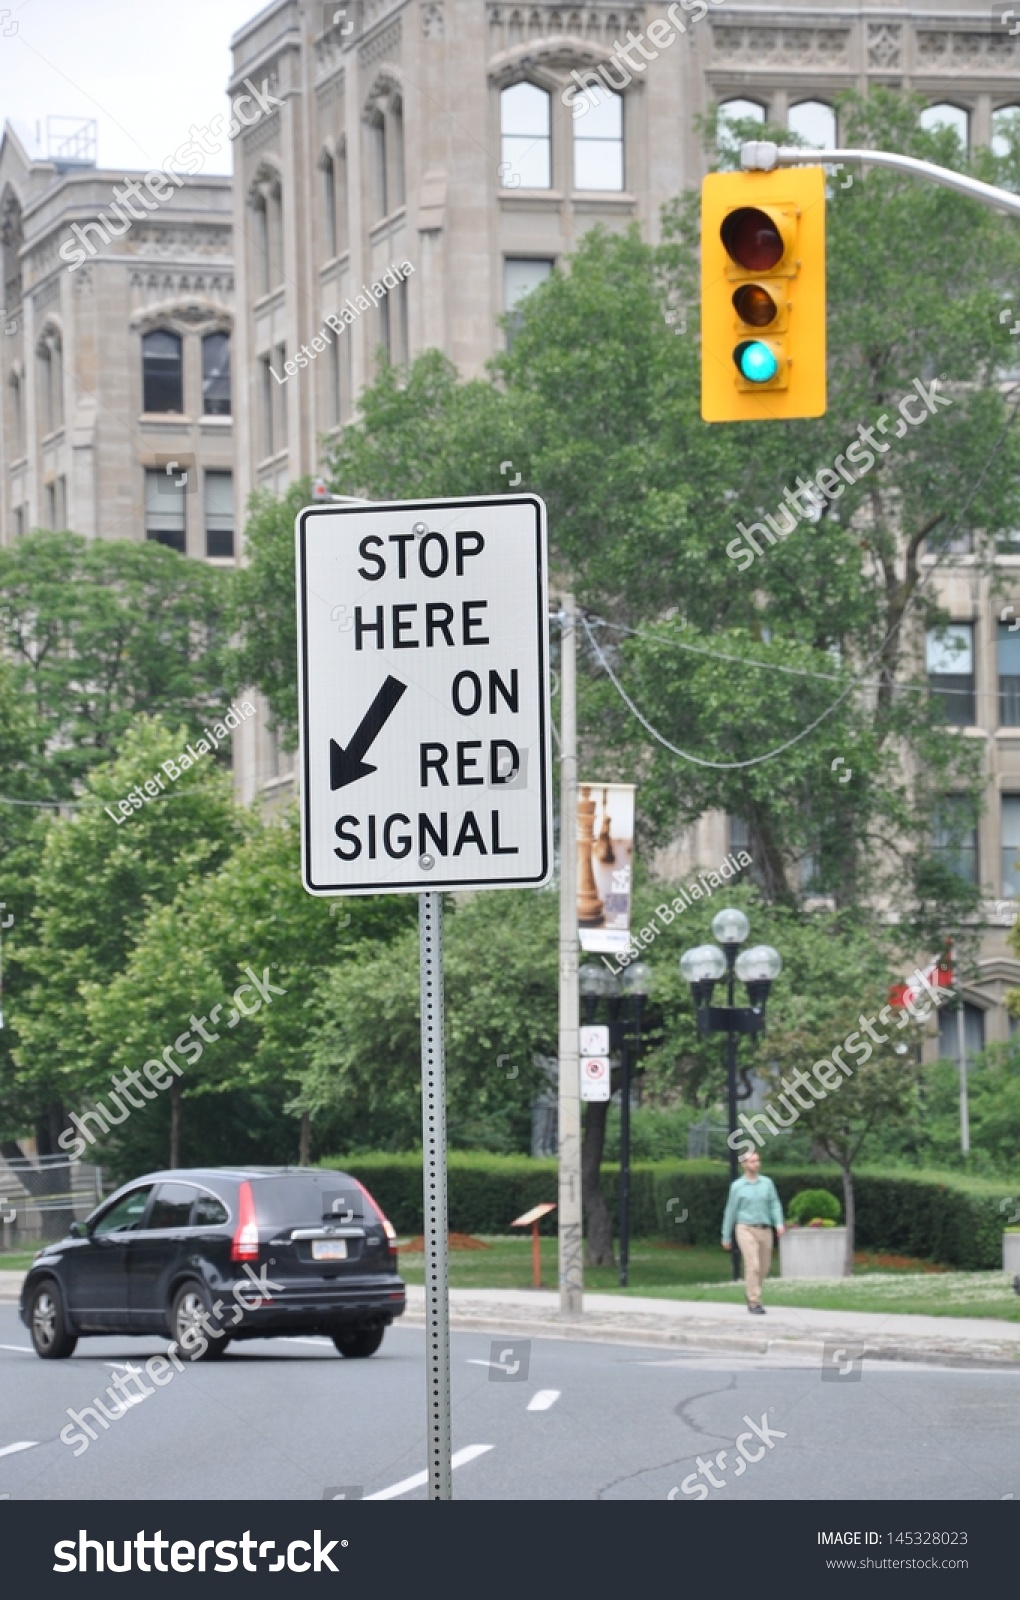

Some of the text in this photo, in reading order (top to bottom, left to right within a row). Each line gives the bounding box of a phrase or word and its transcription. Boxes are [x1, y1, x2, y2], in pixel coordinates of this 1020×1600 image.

[357, 530, 485, 581] STOP
[354, 600, 490, 651] HERE
[451, 668, 519, 716] ON
[419, 739, 520, 787] RED
[333, 810, 519, 861] SIGNAL
